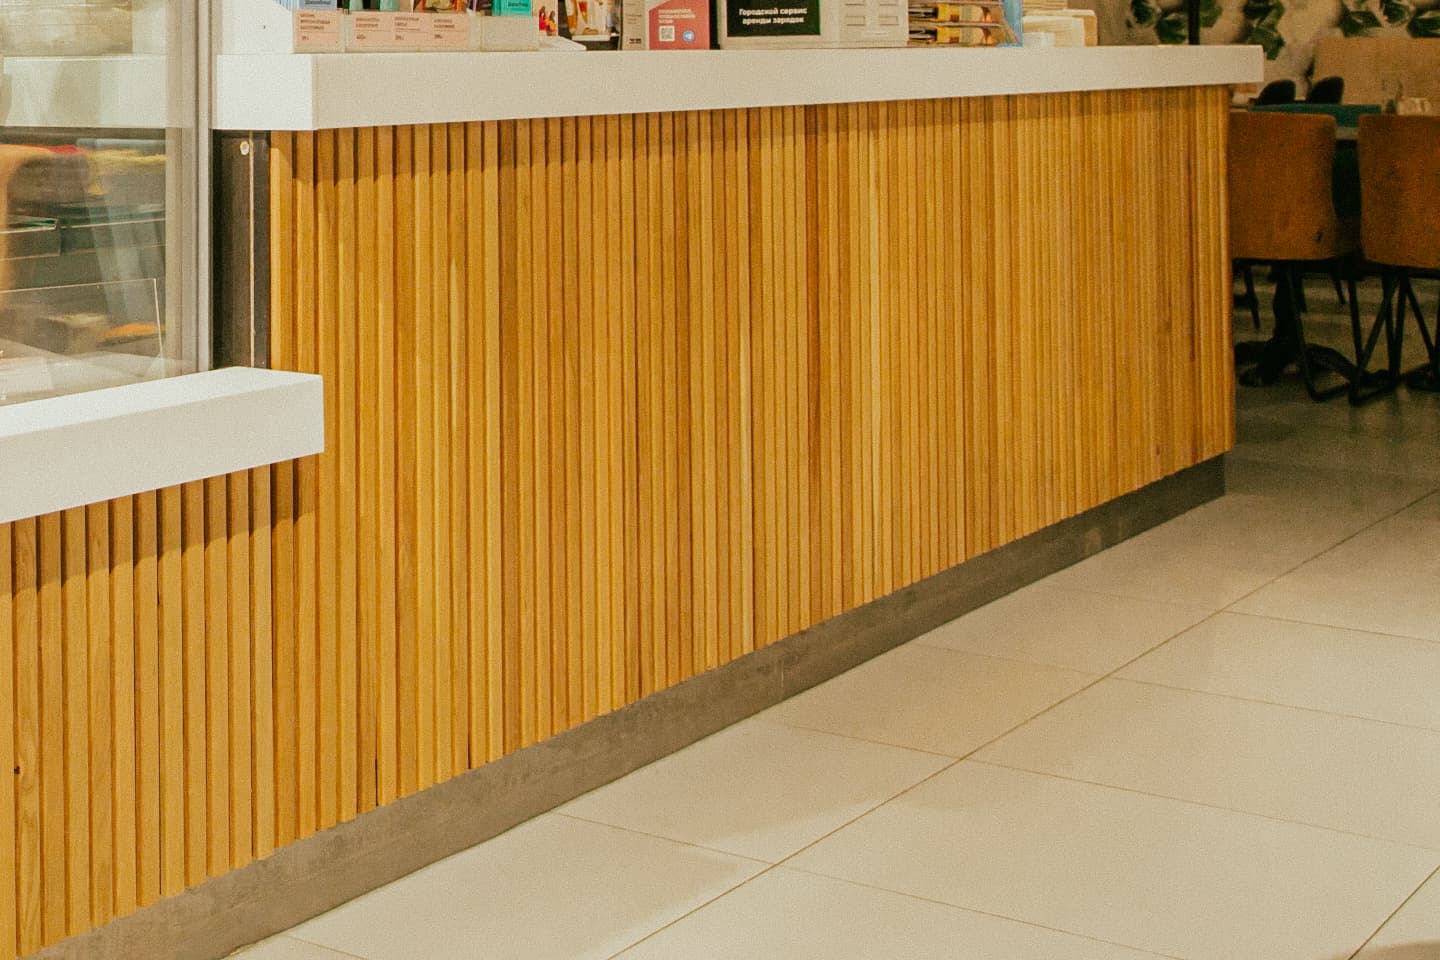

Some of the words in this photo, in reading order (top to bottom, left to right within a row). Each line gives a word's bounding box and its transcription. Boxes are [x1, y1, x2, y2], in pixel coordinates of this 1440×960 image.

[738, 8, 778, 16] Городской
[779, 7, 808, 16] сервис
[742, 18, 772, 26] аренды
[773, 17, 805, 25] зарядок
